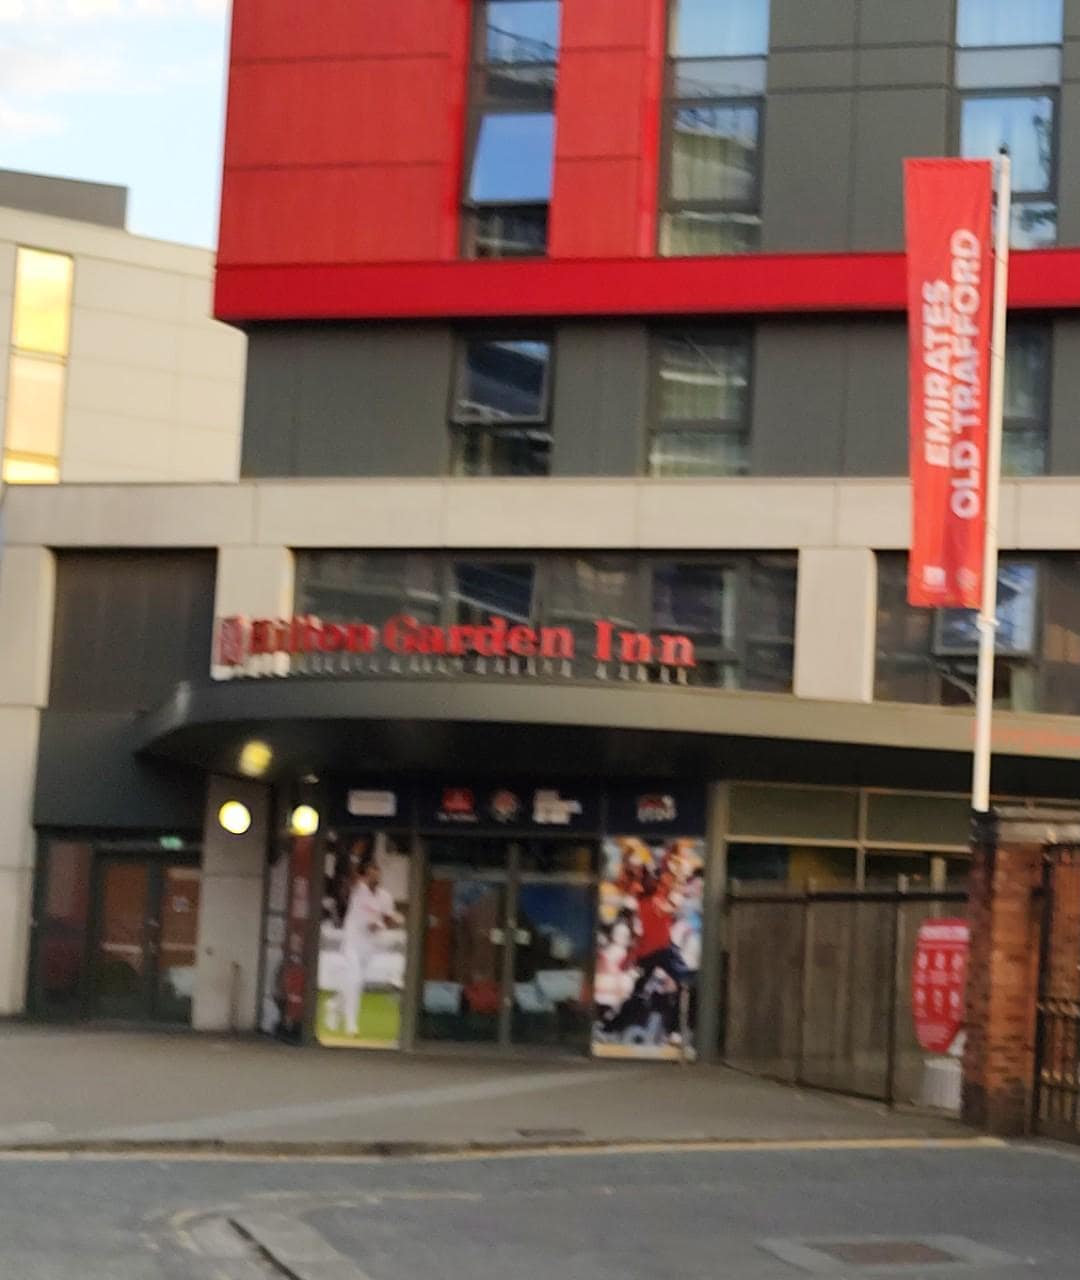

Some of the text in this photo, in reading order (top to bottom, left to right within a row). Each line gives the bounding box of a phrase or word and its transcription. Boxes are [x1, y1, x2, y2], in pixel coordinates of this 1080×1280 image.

[922, 279, 951, 468] EMIRATES
[950, 228, 981, 520] OLD TRAFFORD
[384, 613, 575, 659] Garden
[594, 618, 696, 668] Inn
